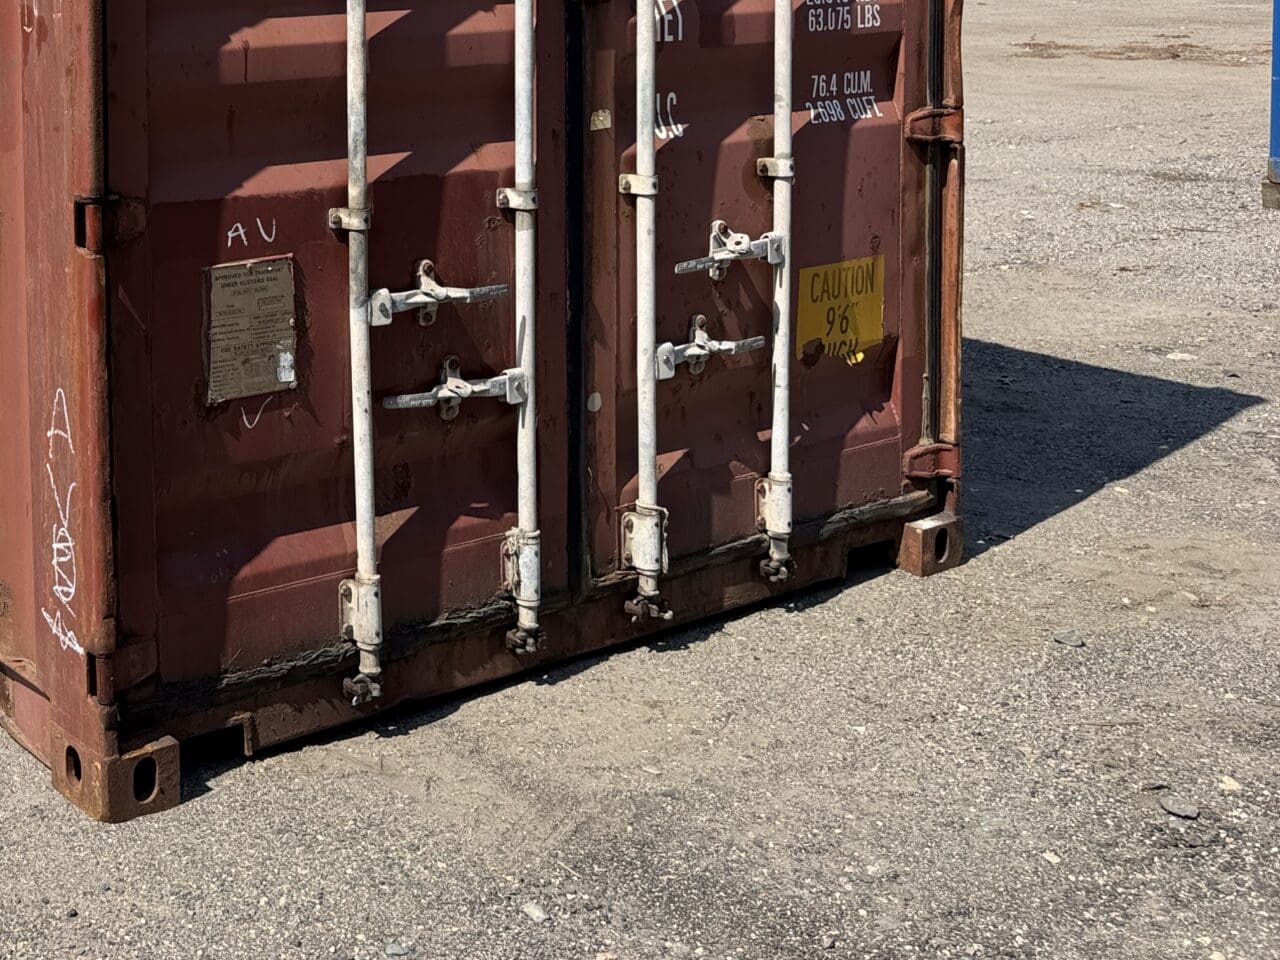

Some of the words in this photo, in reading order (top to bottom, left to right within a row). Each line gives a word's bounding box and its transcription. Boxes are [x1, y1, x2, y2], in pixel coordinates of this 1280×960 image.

[857, 5, 881, 28] LBS
[811, 73, 837, 98] 76.4
[810, 261, 875, 303] CAUTION
